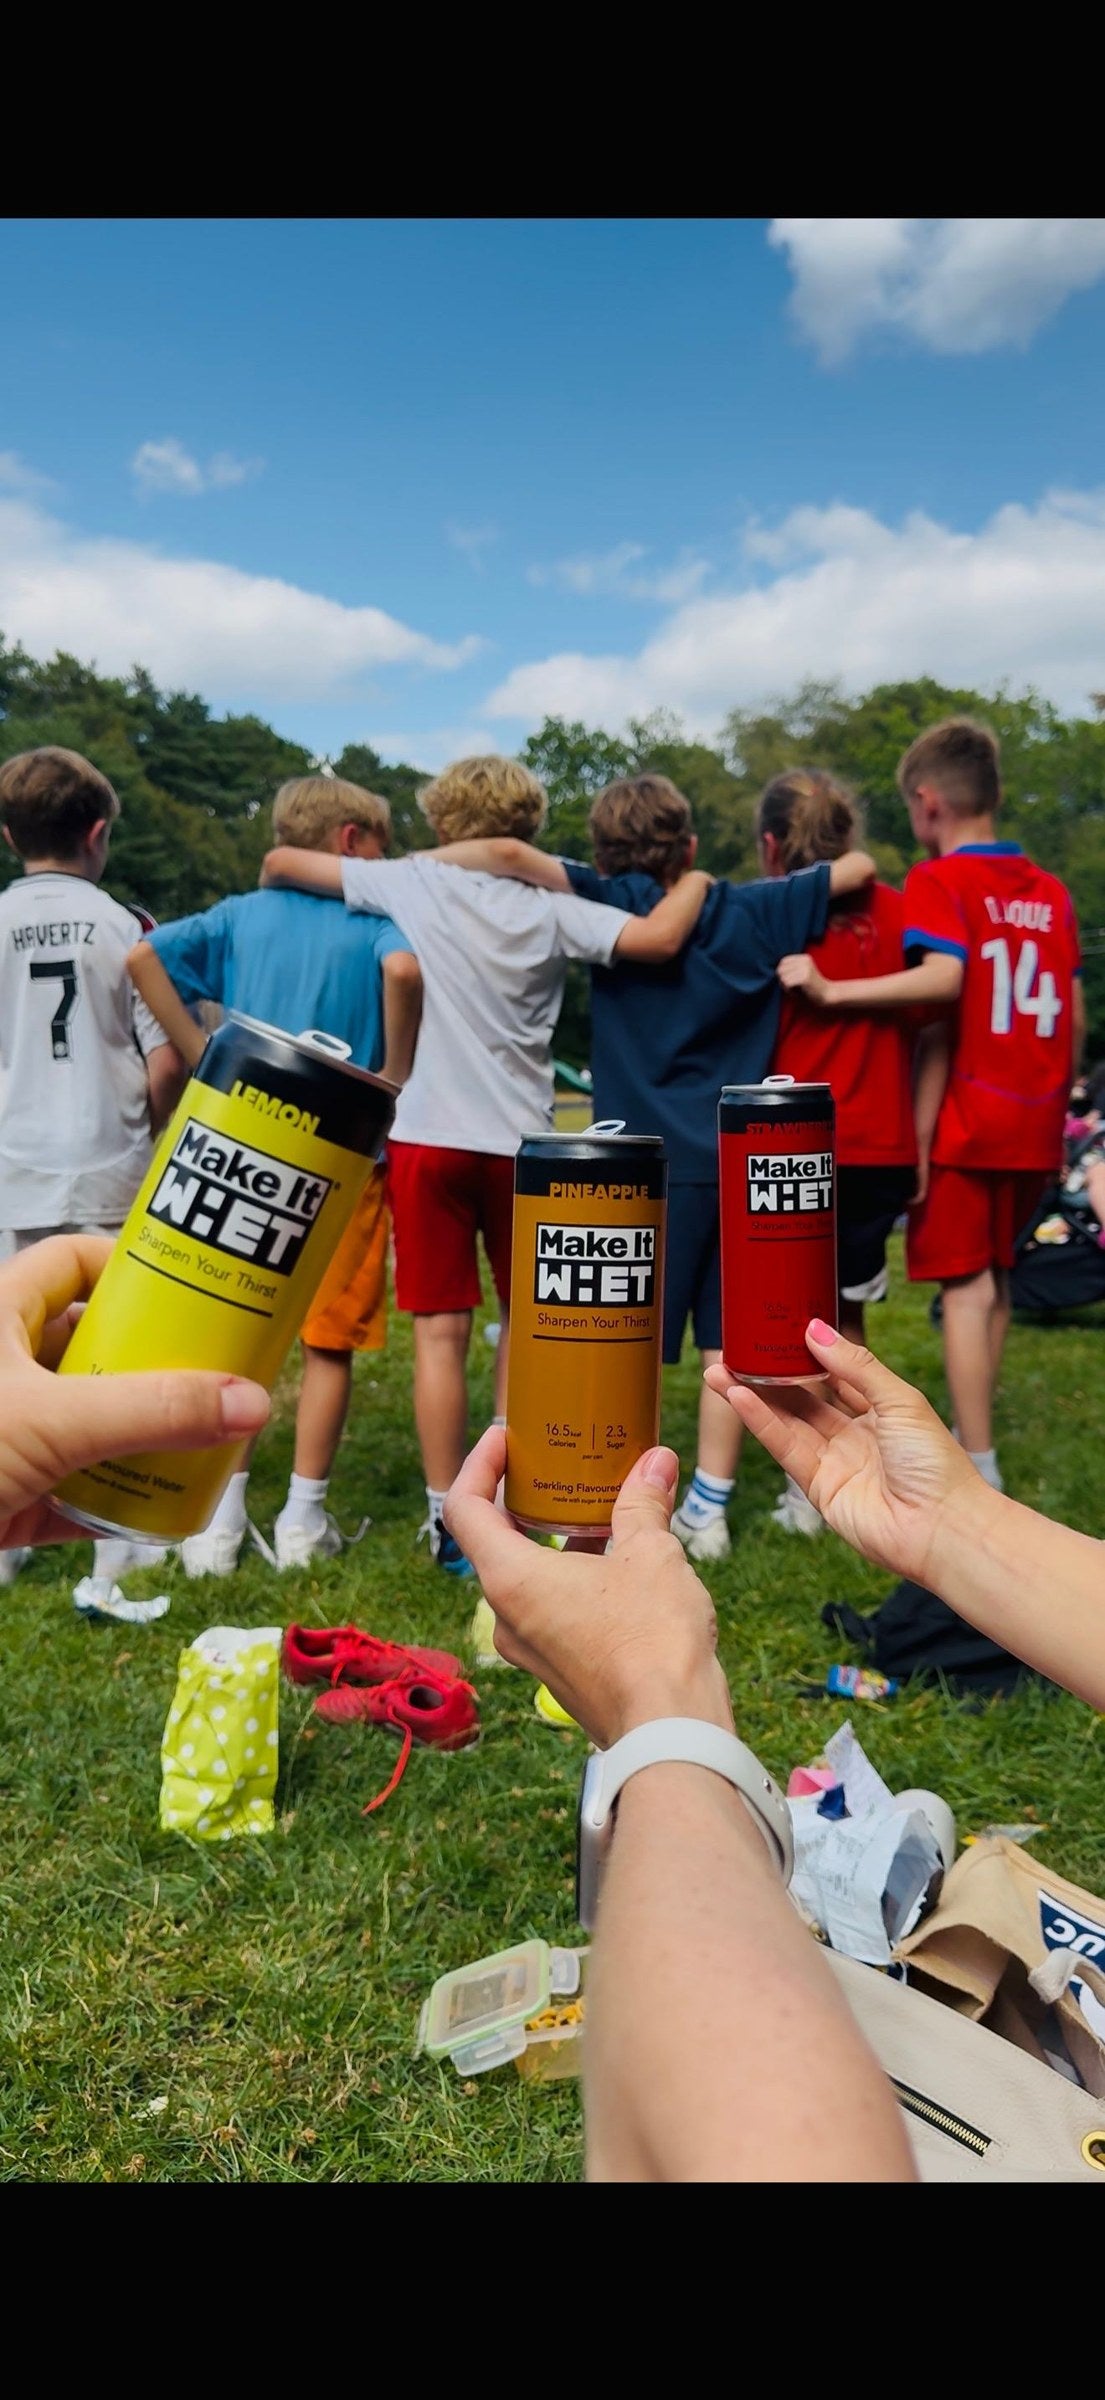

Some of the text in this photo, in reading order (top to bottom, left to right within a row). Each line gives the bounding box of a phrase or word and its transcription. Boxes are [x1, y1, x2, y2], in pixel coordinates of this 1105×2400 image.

[12, 921, 97, 951] HAVERTZ
[981, 938, 1062, 1038] 14
[30, 960, 78, 1061] 7
[230, 1079, 321, 1136] LEMON
[177, 1125, 321, 1216] Make It
[750, 1154, 832, 1178] Make It
[550, 1182, 649, 1200] PINEAPPLE
[540, 1228, 653, 1258] Make It
[138, 1225, 278, 1299] Sharpen Your Thirst
[538, 1312, 650, 1330] Sharpen Your Thirst
[548, 1439, 576, 1449] Calories
[606, 1441, 626, 1450] Sugar
[533, 1478, 622, 1494] Sparkling Flavoured
